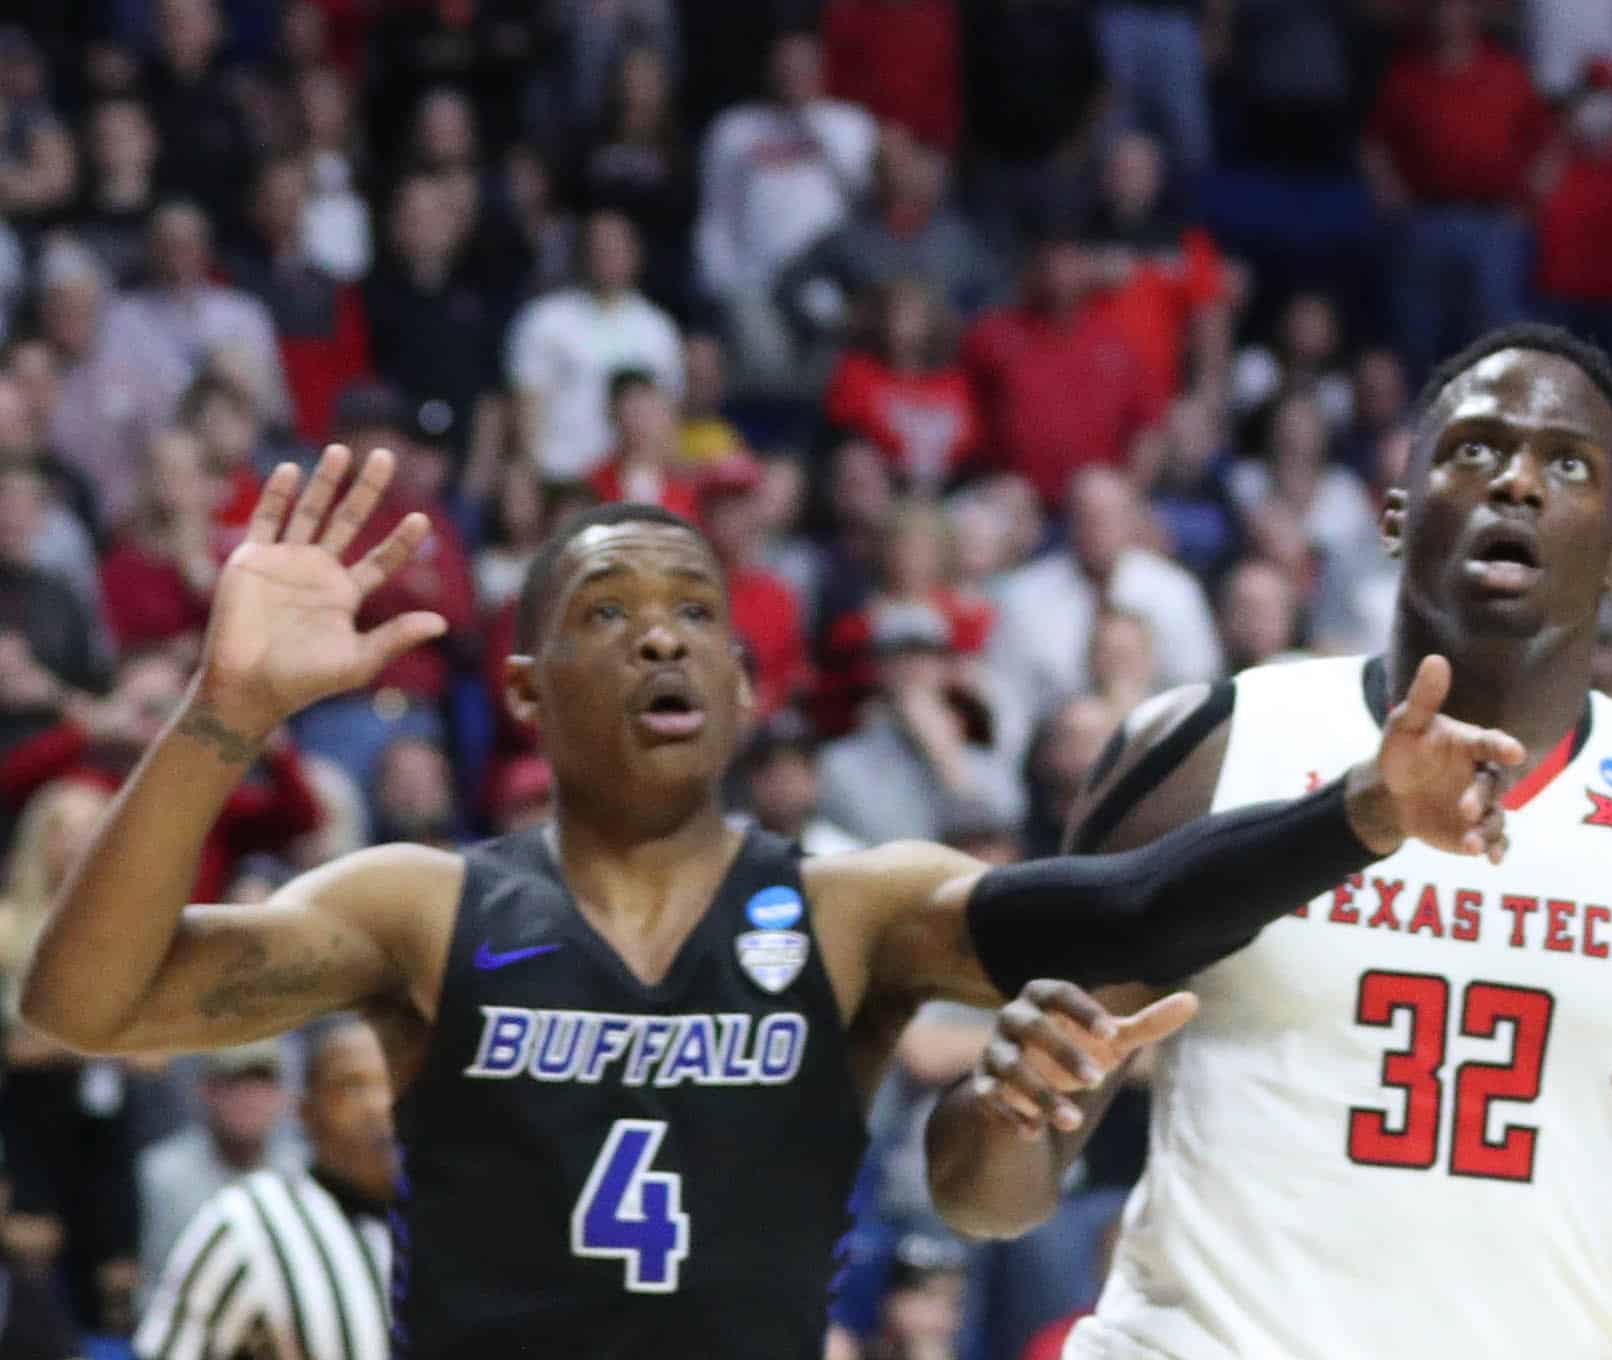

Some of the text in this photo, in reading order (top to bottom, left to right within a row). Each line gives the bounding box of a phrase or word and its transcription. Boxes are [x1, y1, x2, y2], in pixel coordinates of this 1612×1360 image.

[1296, 873, 1483, 942] EXAS
[463, 1004, 808, 1088] BUFFALO
[1347, 969, 1556, 1184] 32
[570, 1118, 690, 1293] 4
